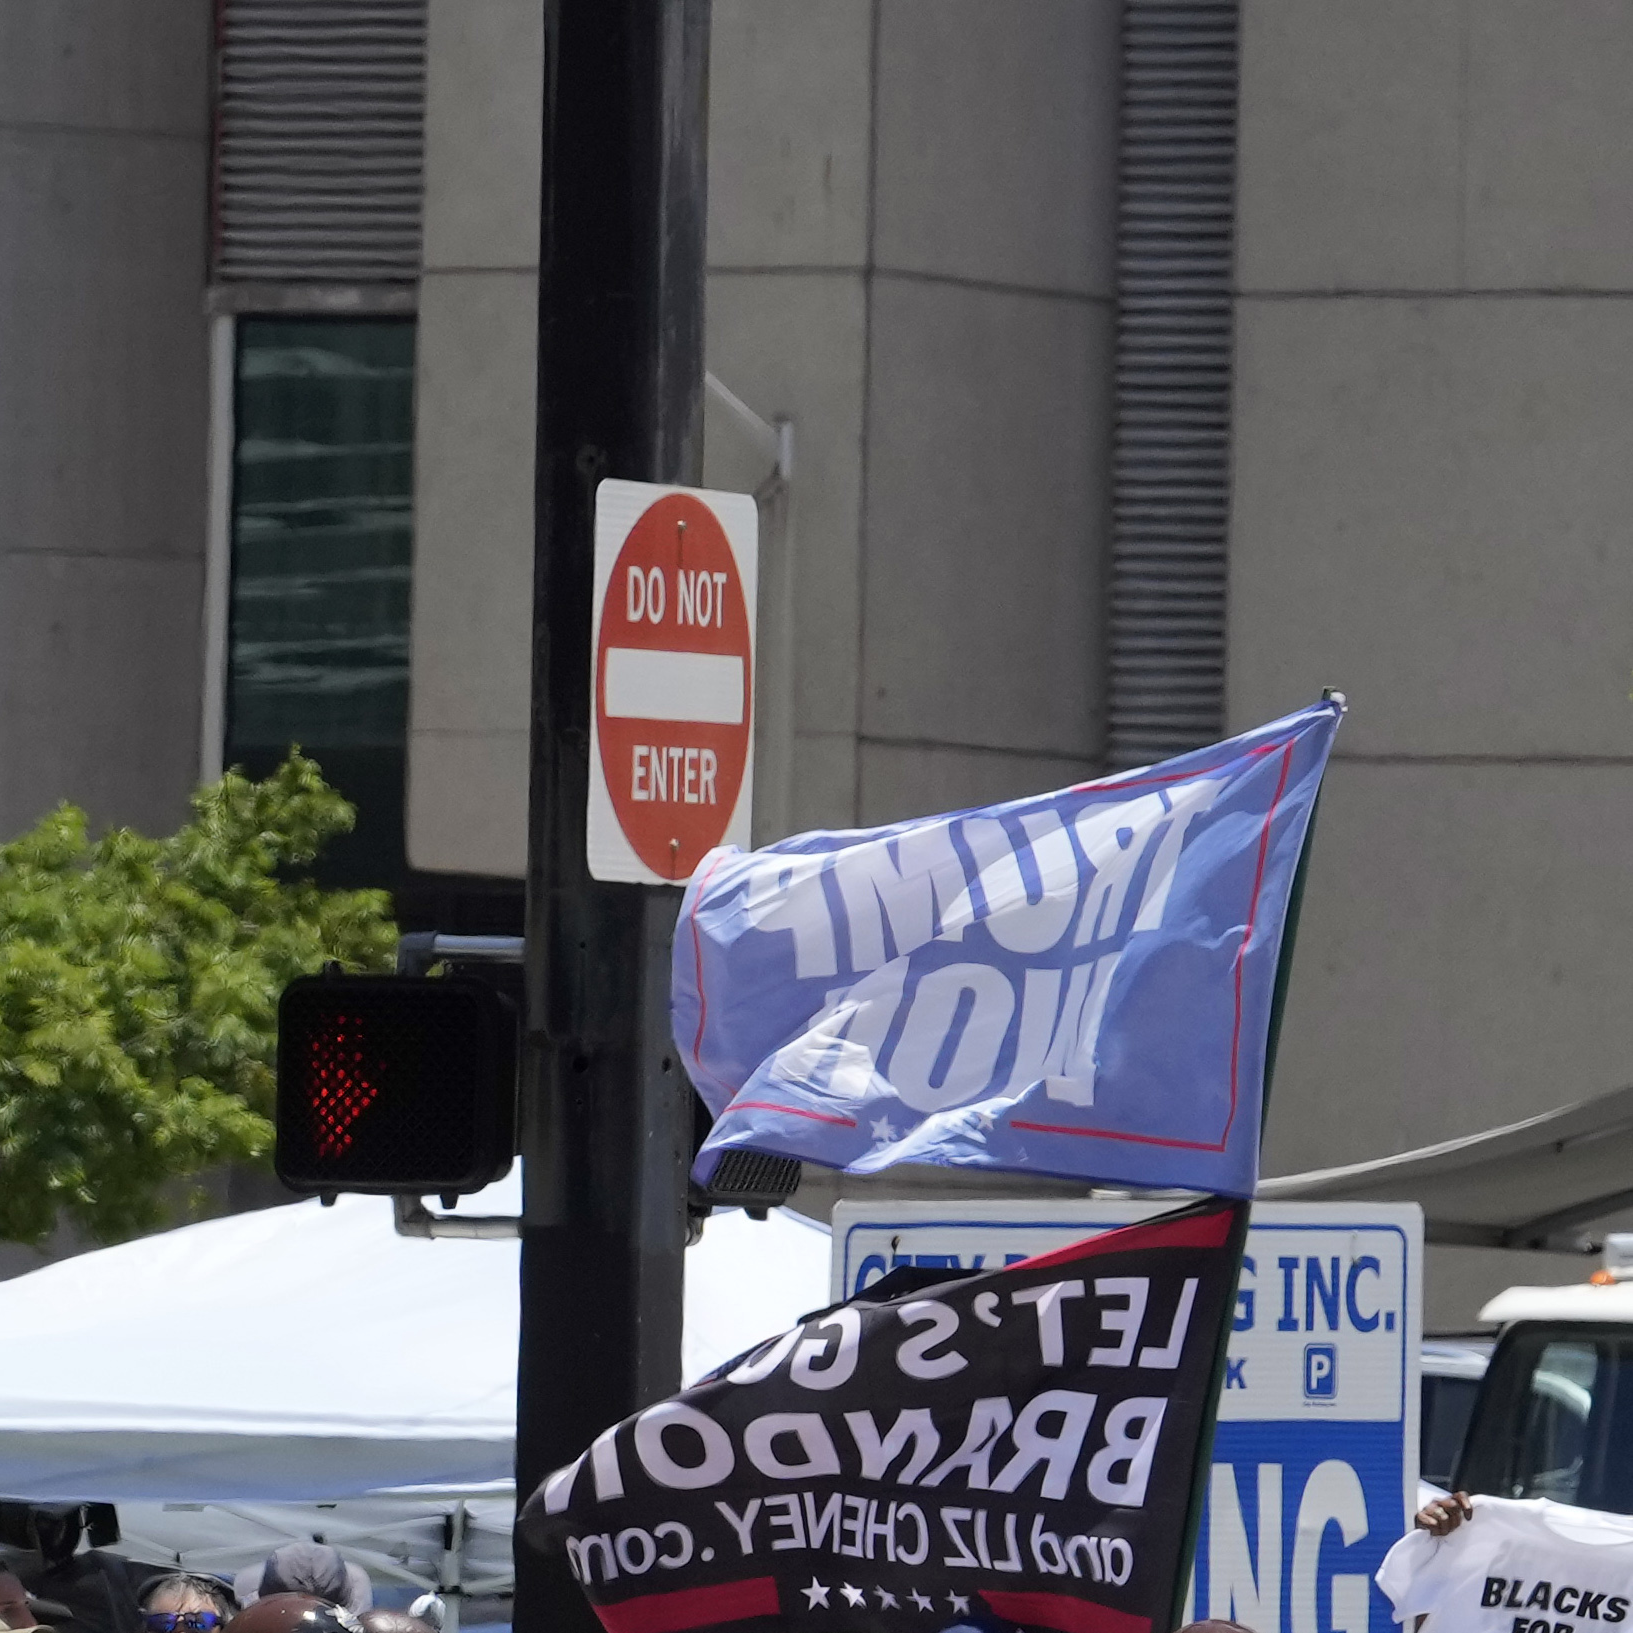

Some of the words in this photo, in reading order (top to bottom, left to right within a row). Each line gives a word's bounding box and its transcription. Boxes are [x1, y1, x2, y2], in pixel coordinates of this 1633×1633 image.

[626, 565, 666, 625] DO
[677, 568, 727, 628] NOT
[631, 744, 718, 805] ENTER
[1277, 1255, 1396, 1333] INC.
[1481, 1576, 1631, 1623] BLACKS
